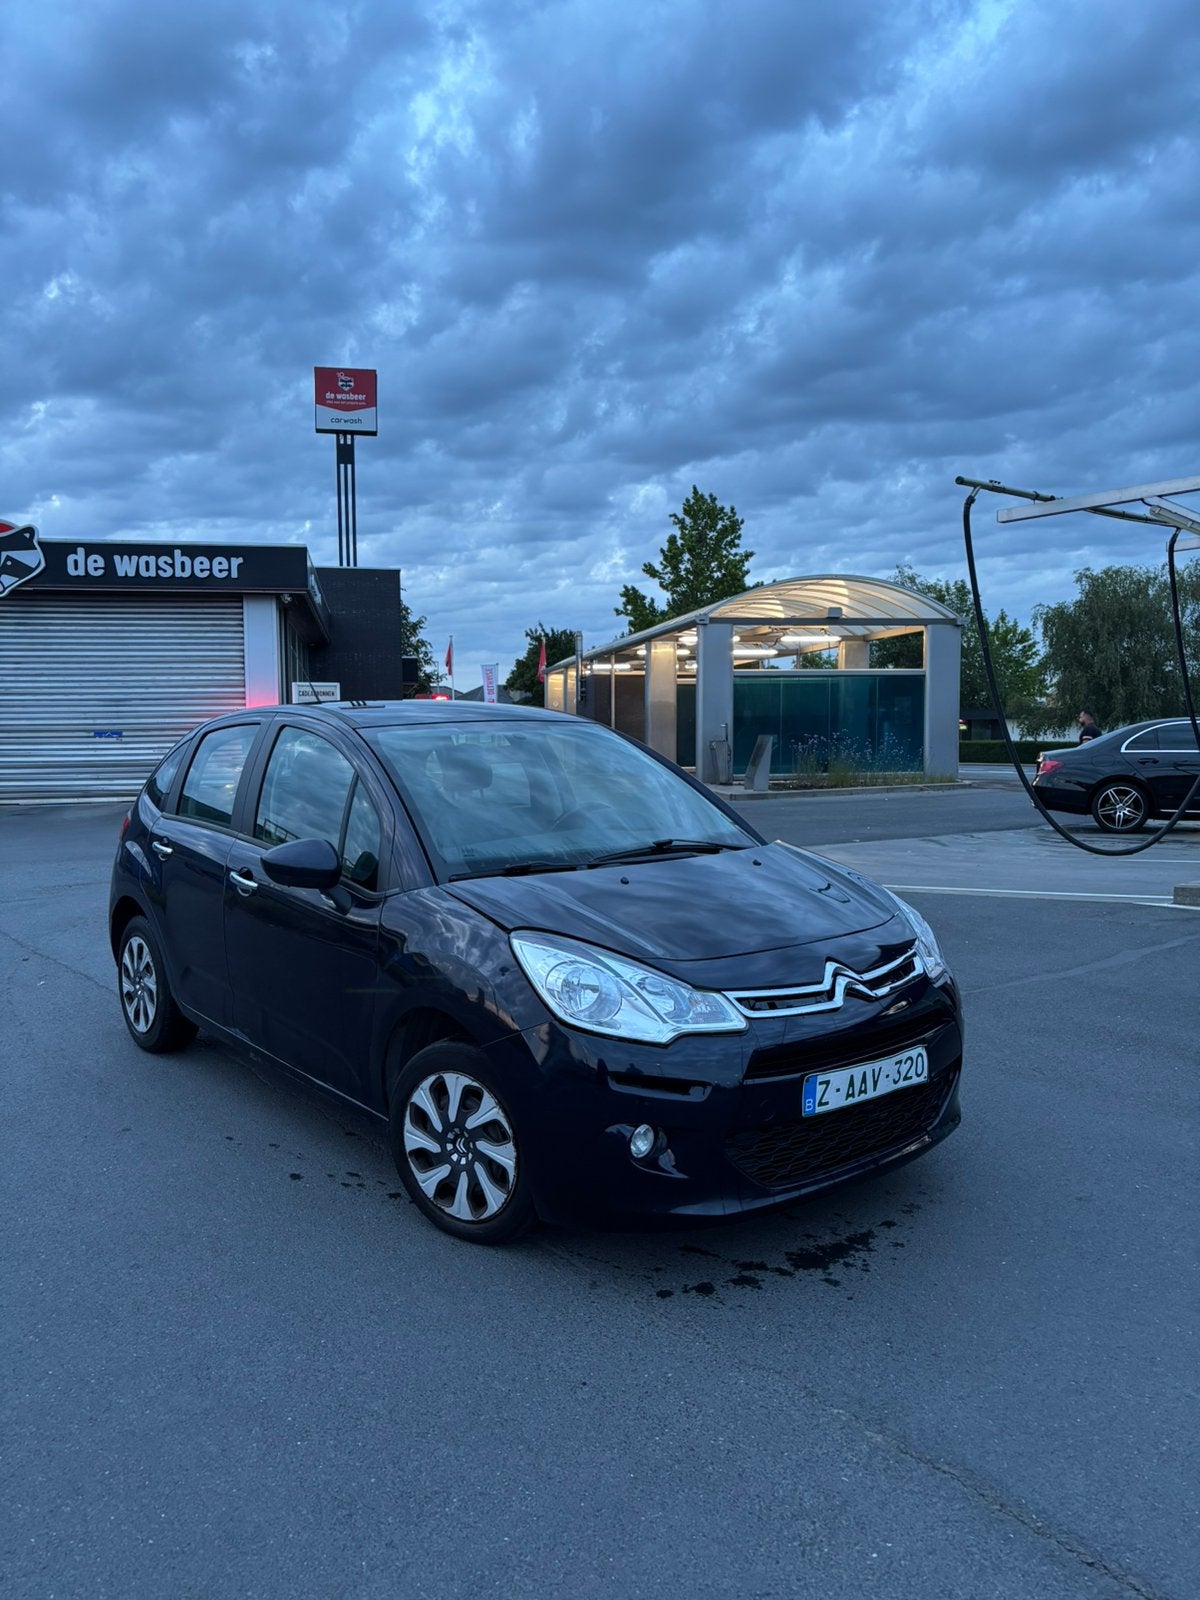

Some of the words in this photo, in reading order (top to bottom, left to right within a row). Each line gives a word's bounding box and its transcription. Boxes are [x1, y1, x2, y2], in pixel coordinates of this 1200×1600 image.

[66, 547, 105, 577] de
[113, 549, 243, 579] wasbeer
[817, 1053, 925, 1108] Z-AAV-320
[805, 1098, 814, 1111] B
